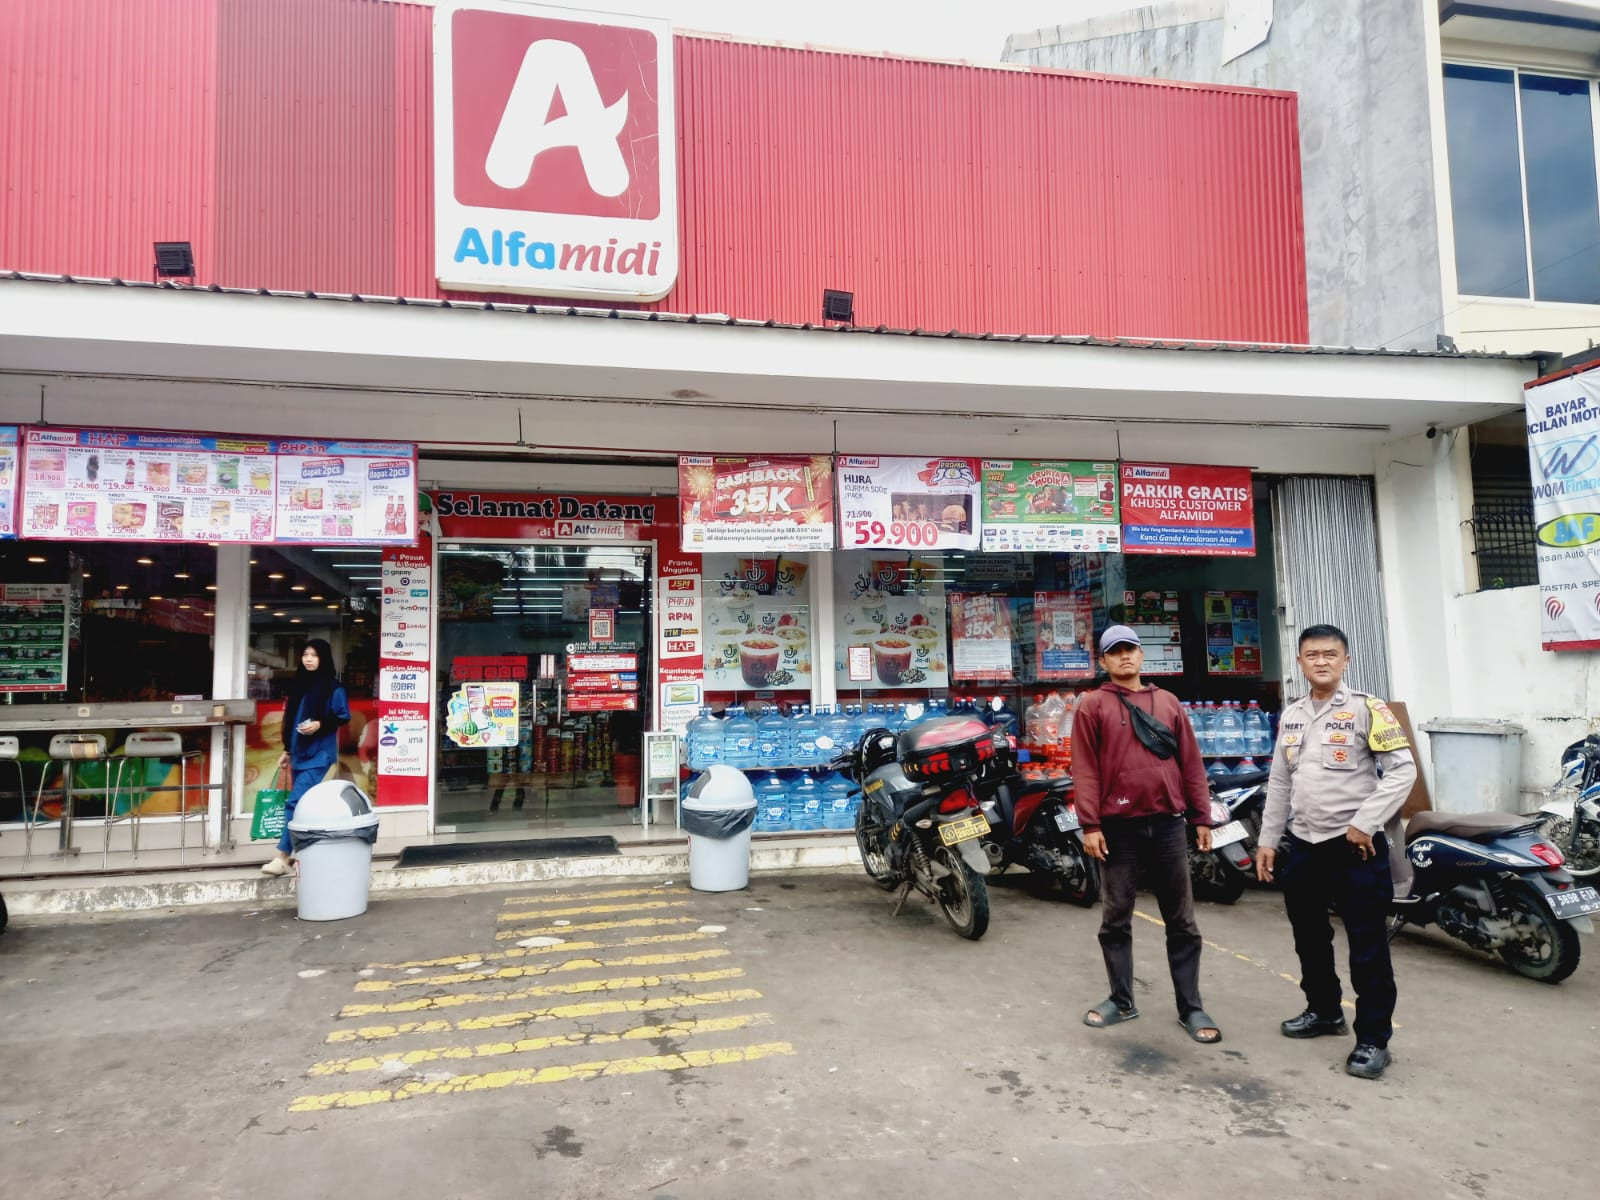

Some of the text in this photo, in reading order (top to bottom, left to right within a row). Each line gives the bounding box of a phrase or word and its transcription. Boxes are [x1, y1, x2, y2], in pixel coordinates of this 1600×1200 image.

[453, 227, 662, 276] Alfamidi
[1545, 397, 1587, 418] BAYAR
[1571, 406, 1600, 425] MOT
[89, 432, 129, 446] HAP
[281, 443, 326, 453] PHP-in
[940, 461, 966, 469] PROMO
[302, 465, 340, 478] dapat 2pcs
[369, 468, 407, 480] dapat 2pcs
[931, 468, 977, 485] JOS
[1135, 468, 1167, 478] Alfamidi
[716, 467, 802, 490] CASHBACK
[1035, 477, 1061, 487] MUDIK
[73, 481, 99, 490] 24.900
[844, 485, 888, 495] KURMA 500g
[1123, 483, 1248, 501] PARKIR GRATIS
[730, 486, 795, 516] 35K
[1130, 498, 1242, 511] KHUSUS CUSTOMER
[437, 493, 655, 525] Selamat Datang
[846, 510, 872, 518] 71.900
[1159, 510, 1214, 521] ALFAMIDI
[539, 528, 551, 537] di
[574, 525, 624, 537] Alfamidi
[707, 527, 726, 535] Setiap
[854, 520, 938, 546] 59.900
[1139, 533, 1158, 541] Kunci
[1182, 535, 1218, 543] Kendaraan
[400, 553, 424, 561] Pesan
[1565, 550, 1584, 559] Auto
[404, 561, 428, 569] Bayar
[662, 566, 699, 575] Unggulan
[671, 580, 691, 588] JSM
[668, 612, 693, 621] RPM
[665, 629, 680, 637] TTM
[965, 621, 995, 637] 35K
[668, 641, 695, 651] HAP
[407, 665, 426, 673] Uang
[660, 667, 703, 676] Keuntungan
[400, 683, 416, 691] BRI
[1325, 722, 1354, 731] POLRI
